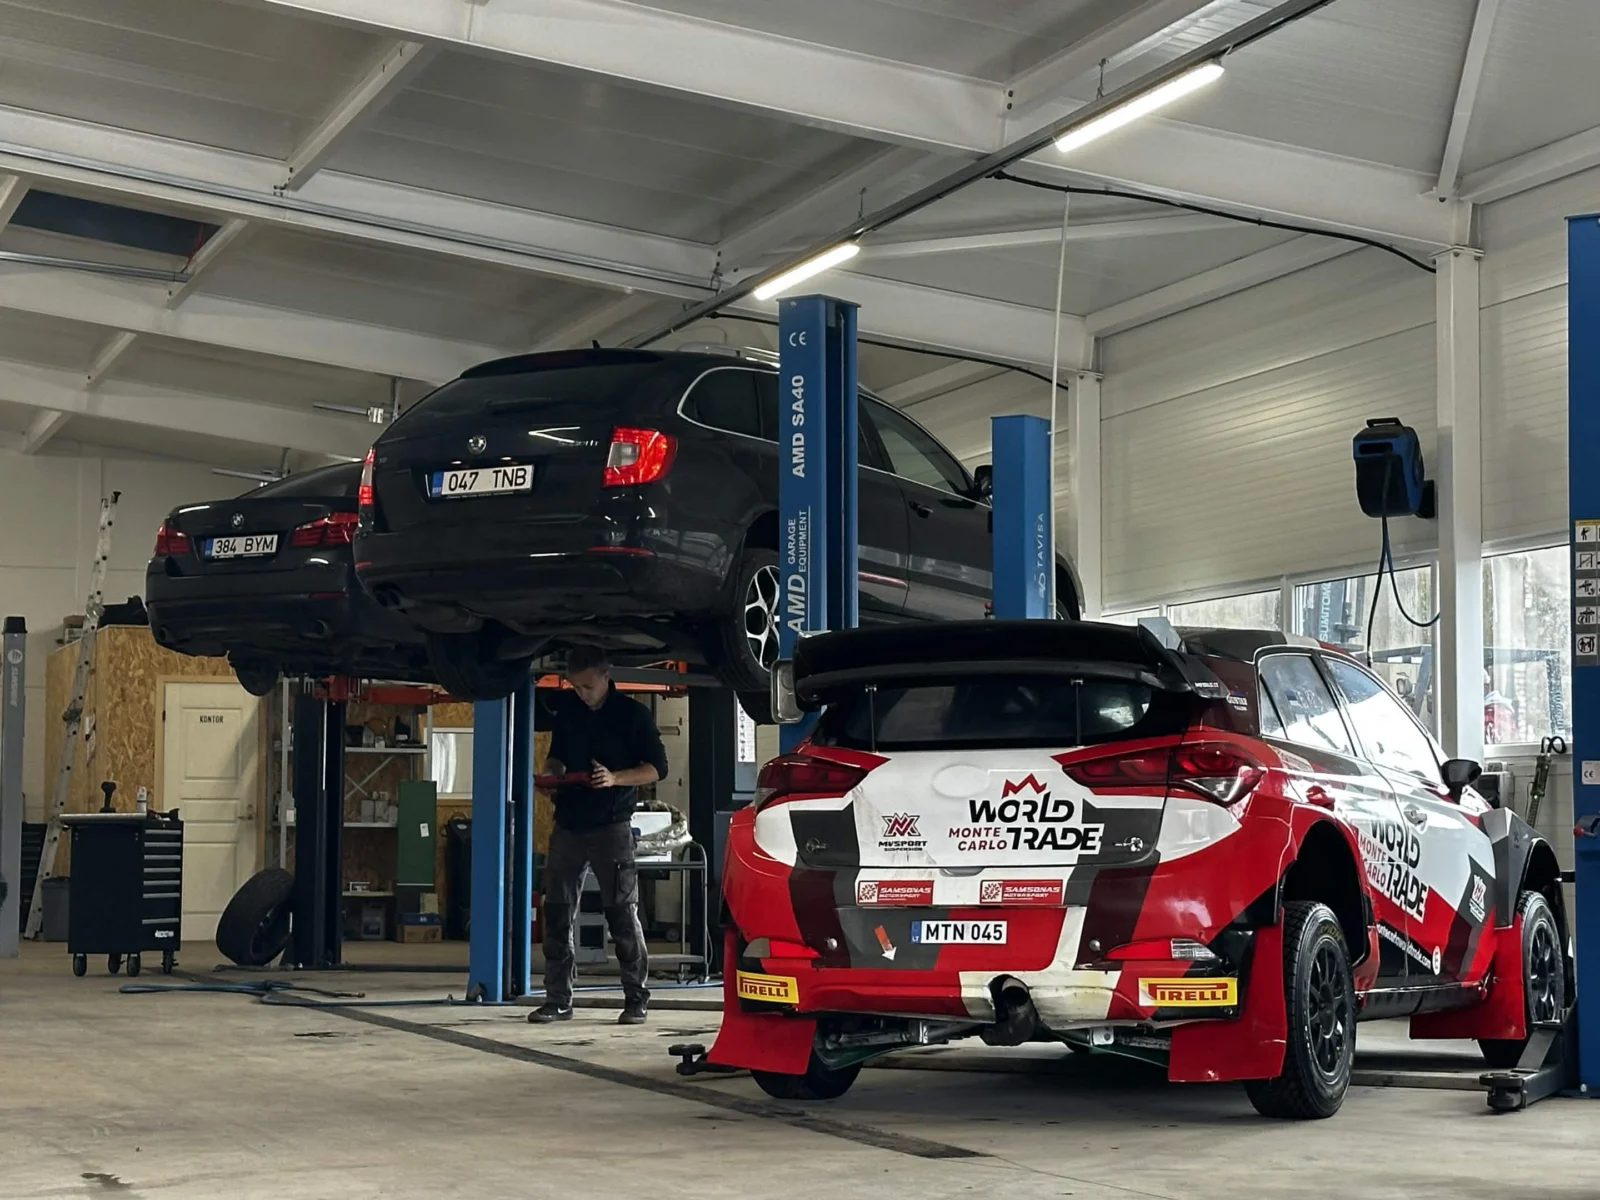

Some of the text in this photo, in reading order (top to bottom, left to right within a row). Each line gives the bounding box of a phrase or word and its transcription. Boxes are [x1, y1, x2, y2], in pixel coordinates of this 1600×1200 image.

[791, 375, 805, 478] AMD SA40
[449, 467, 527, 492] 047 TNB
[215, 539, 237, 553] 384
[244, 536, 274, 552] BYM
[787, 518, 797, 565] GARAGE
[798, 510, 808, 573] EQUIPMENT
[1036, 513, 1045, 568] TAVISA
[787, 573, 806, 633] AMD
[199, 715, 224, 723] KONTOR
[969, 791, 1075, 823] WORLD
[948, 827, 1001, 838] MONTE
[957, 840, 1007, 851] CARLO
[1006, 827, 1100, 850] TRADE
[1371, 820, 1421, 869] WORLD
[1360, 834, 1386, 867] MONTE
[1386, 856, 1428, 918] TRADE
[926, 923, 1003, 941] MTN 045
[739, 976, 789, 998] PIRELLI
[1147, 983, 1228, 1001] PIRELLI
